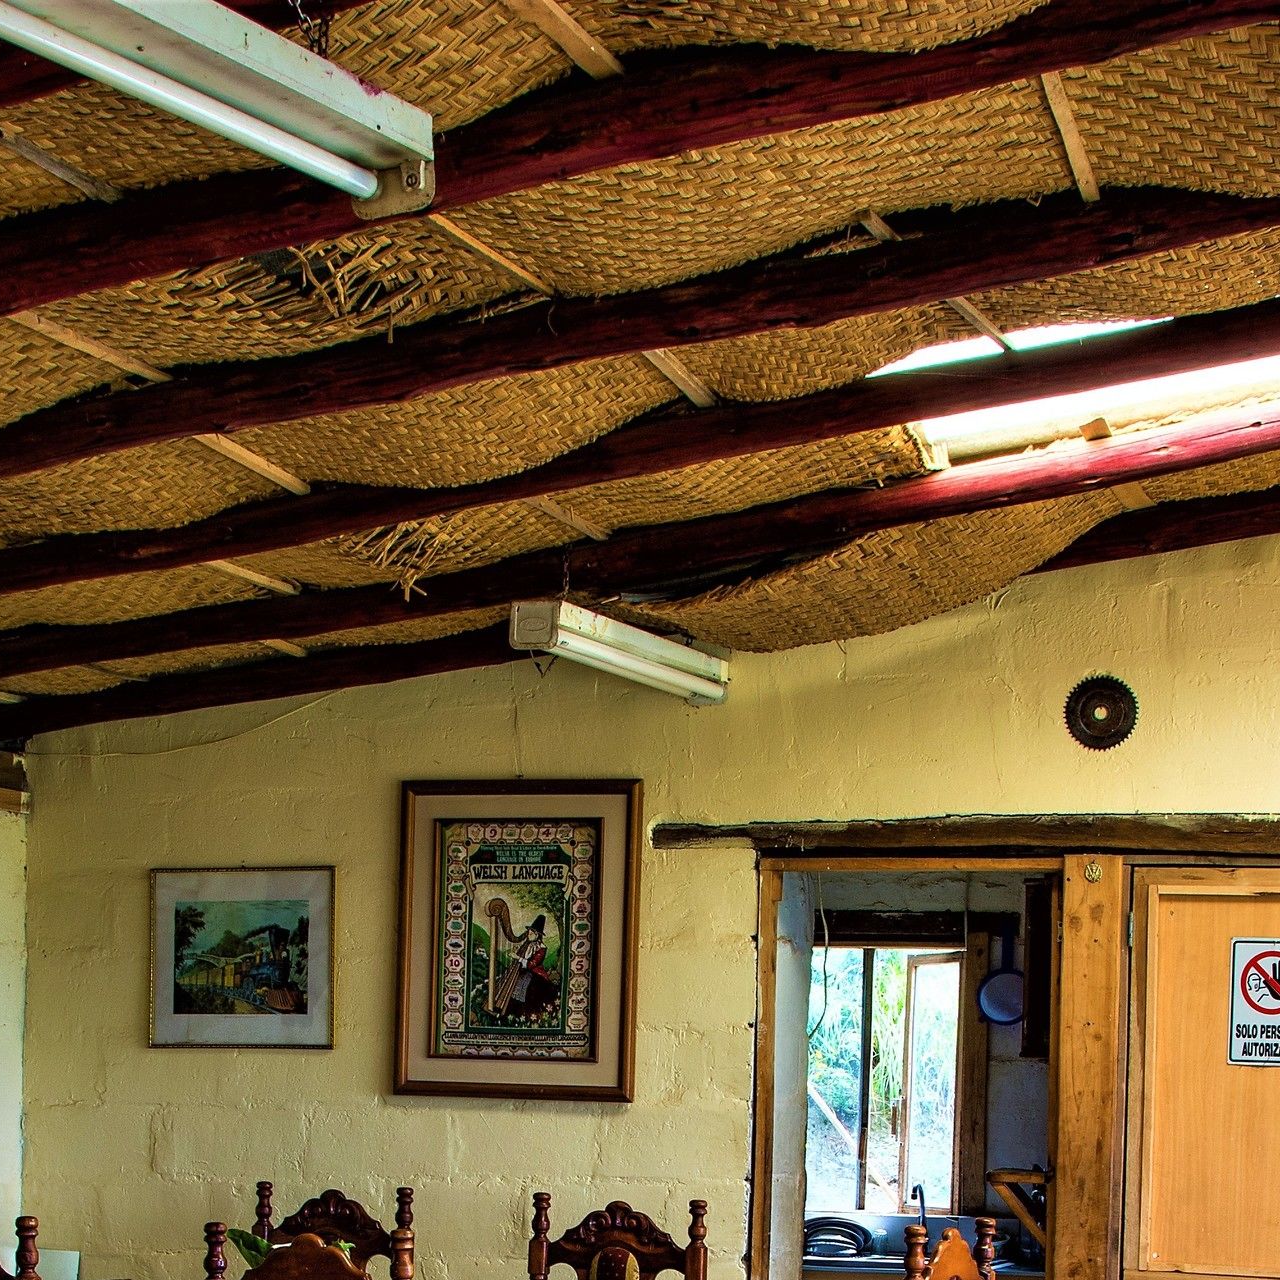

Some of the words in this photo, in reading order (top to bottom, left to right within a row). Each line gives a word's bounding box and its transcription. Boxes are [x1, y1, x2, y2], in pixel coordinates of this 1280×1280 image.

[472, 865, 508, 880] WELSH
[512, 865, 564, 880] LANGUAGE
[449, 958, 460, 968] 10
[1235, 1024, 1258, 1039] SOLO
